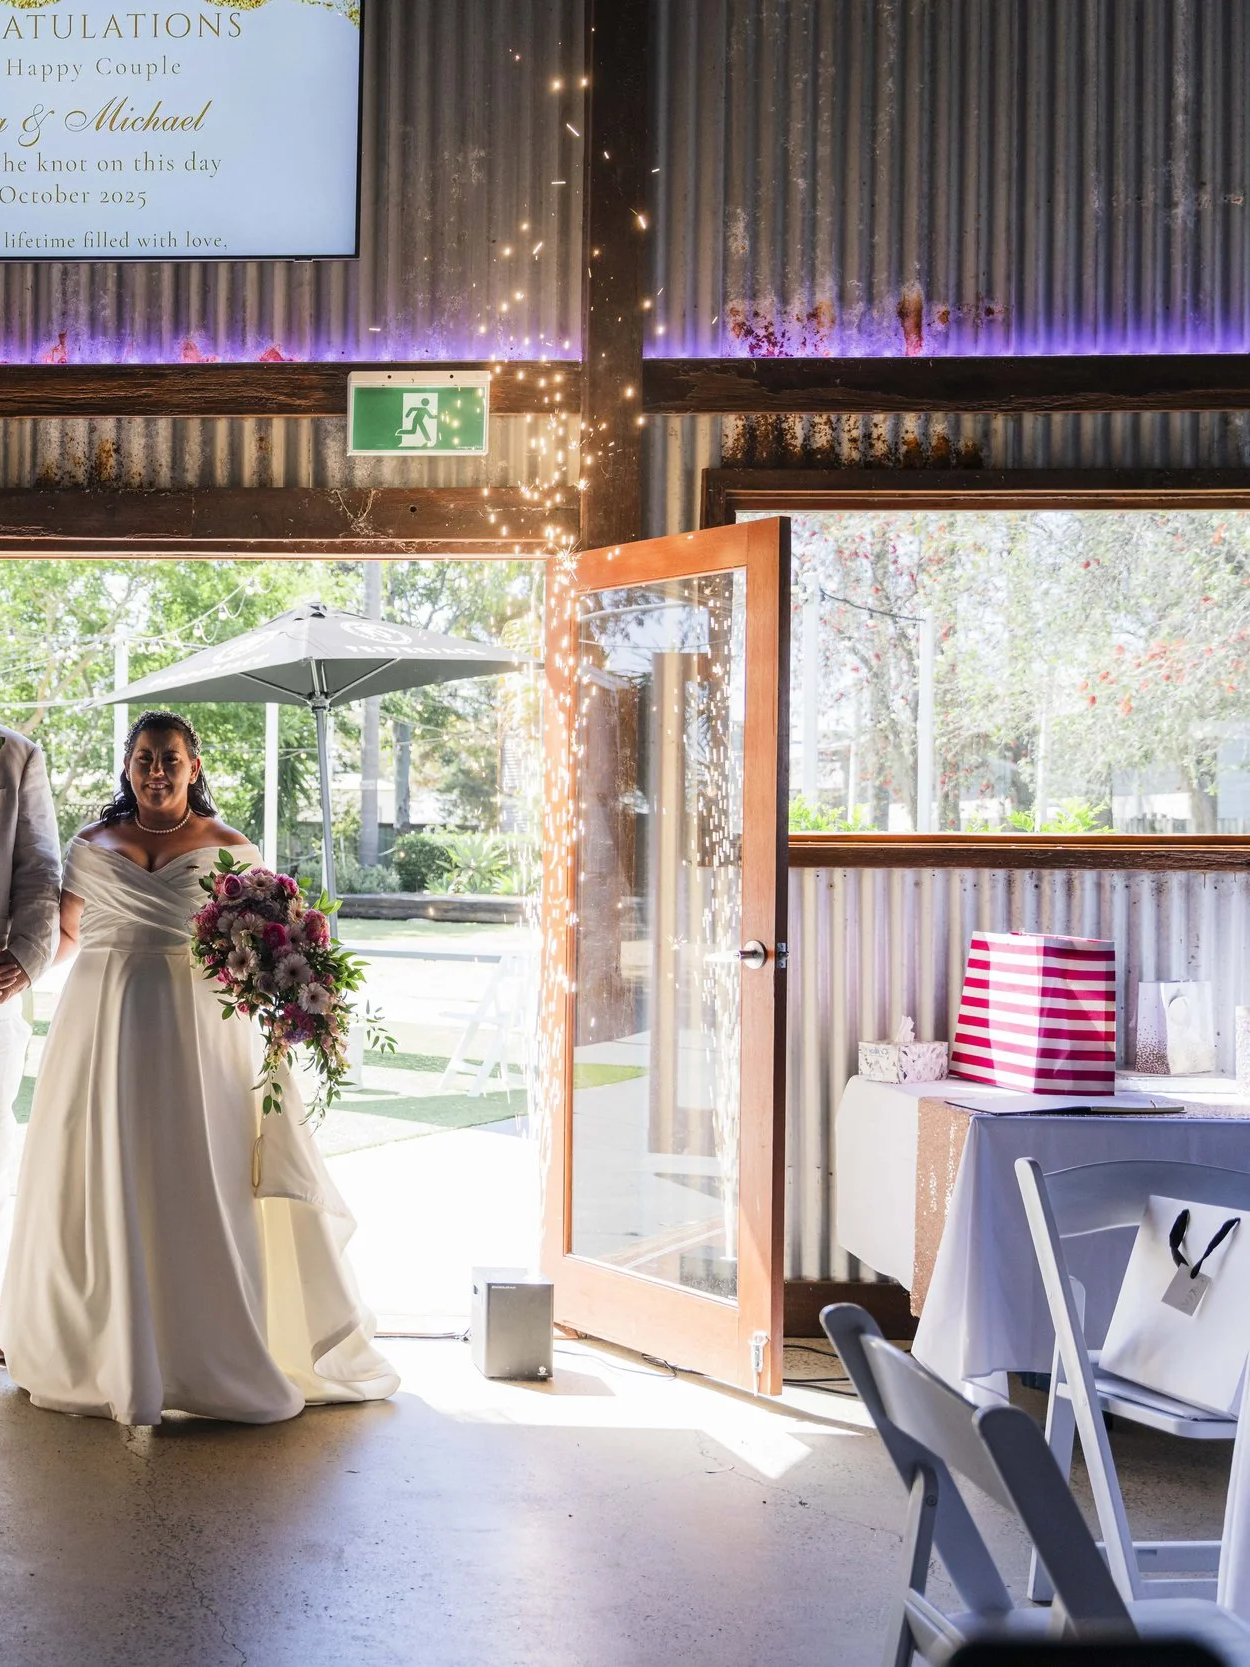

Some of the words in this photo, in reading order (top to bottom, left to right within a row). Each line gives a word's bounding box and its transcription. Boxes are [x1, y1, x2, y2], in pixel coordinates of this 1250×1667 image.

[7, 58, 83, 82] Happy
[96, 56, 180, 81] Couple
[18, 104, 55, 147] &
[65, 96, 212, 132] Michael
[38, 152, 86, 172] knot
[97, 159, 123, 172] on
[135, 151, 174, 171] this
[185, 151, 221, 177] day
[0, 184, 89, 203] October
[100, 192, 146, 209] 2025
[5, 232, 75, 248] lifetime
[84, 231, 129, 248] filled
[138, 231, 176, 247] with
[186, 231, 228, 250] love,
